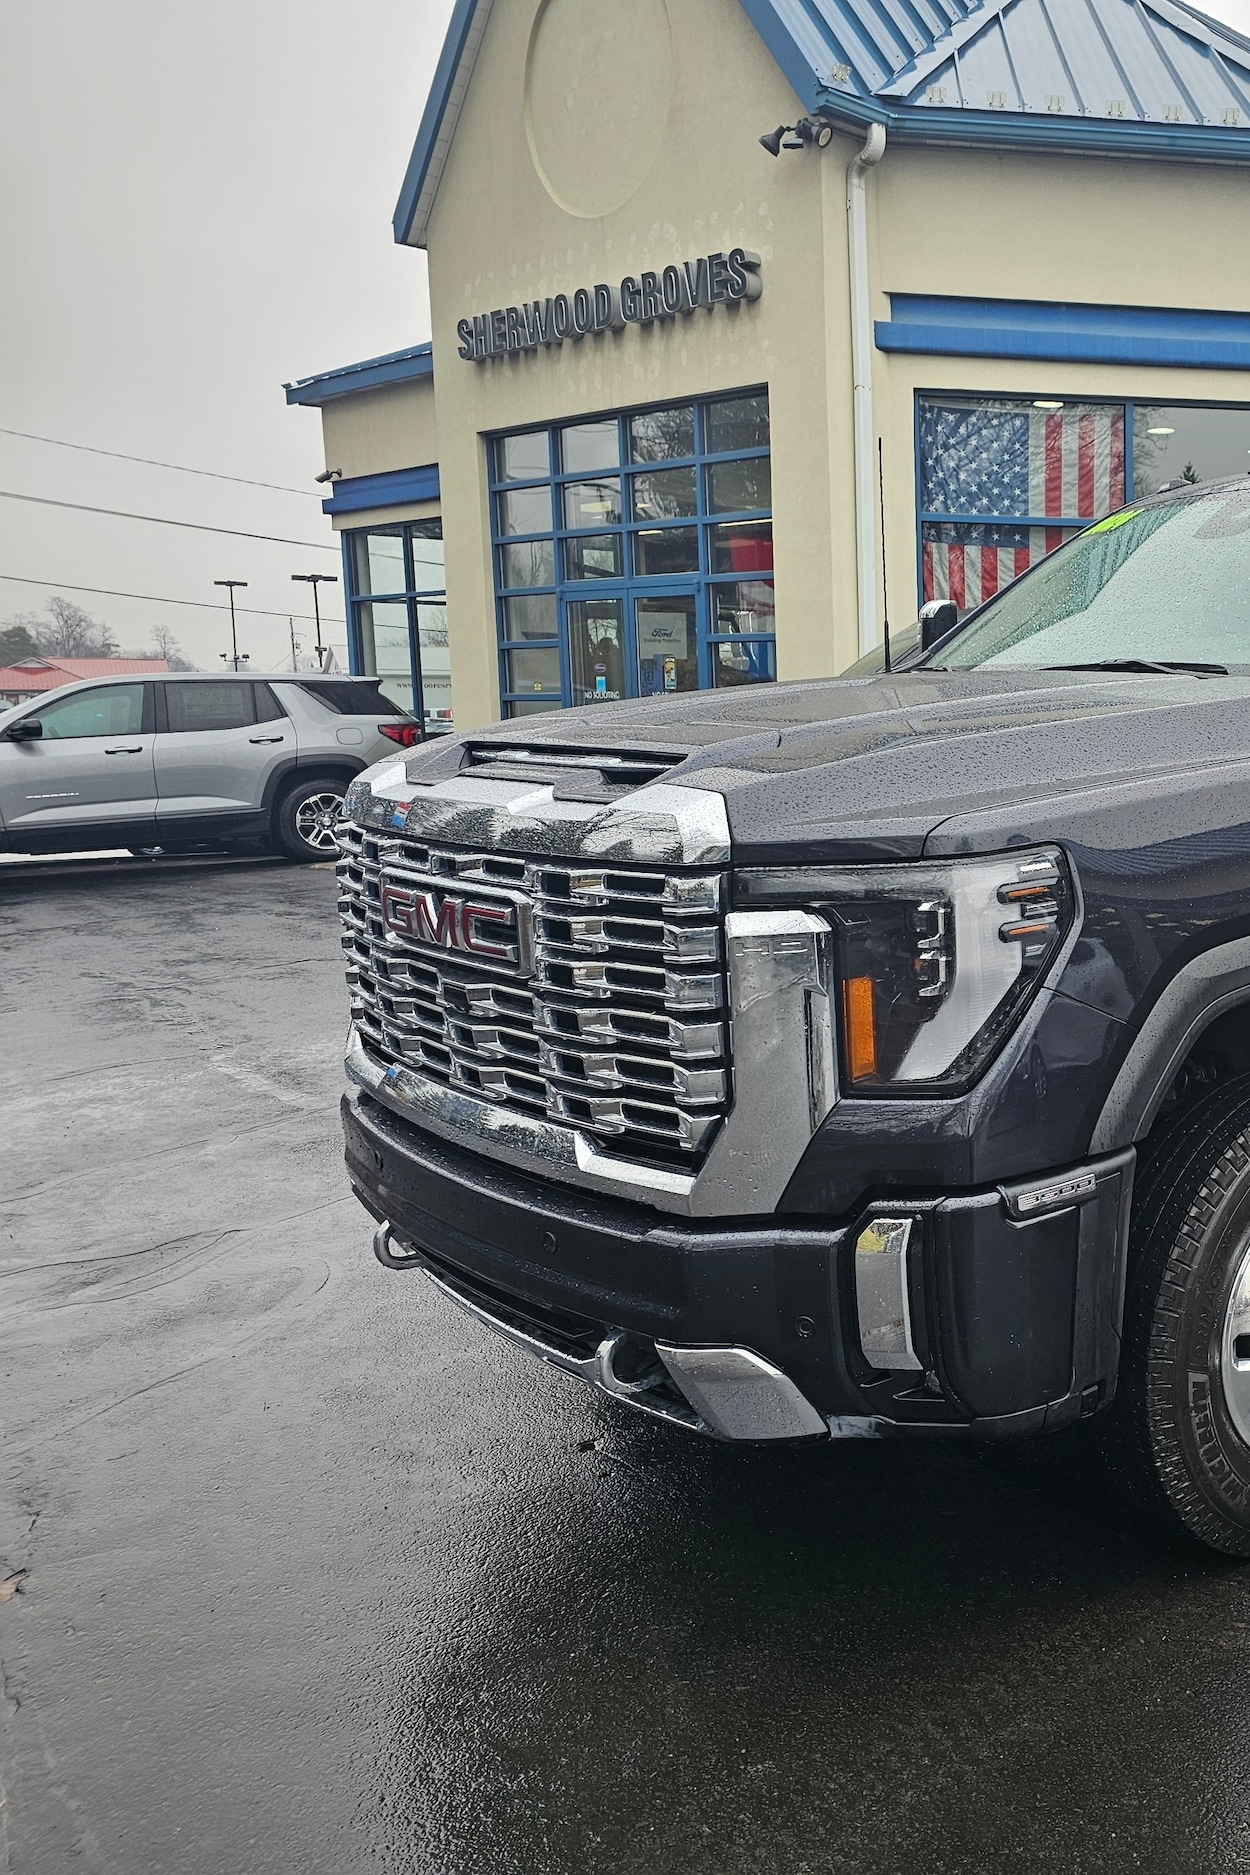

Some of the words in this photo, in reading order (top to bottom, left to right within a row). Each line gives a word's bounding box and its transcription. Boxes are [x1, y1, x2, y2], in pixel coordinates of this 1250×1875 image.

[457, 283, 622, 360] SHERWOOD
[620, 248, 760, 323] GROVES
[651, 628, 673, 638] Ford
[383, 885, 516, 962] GMC
